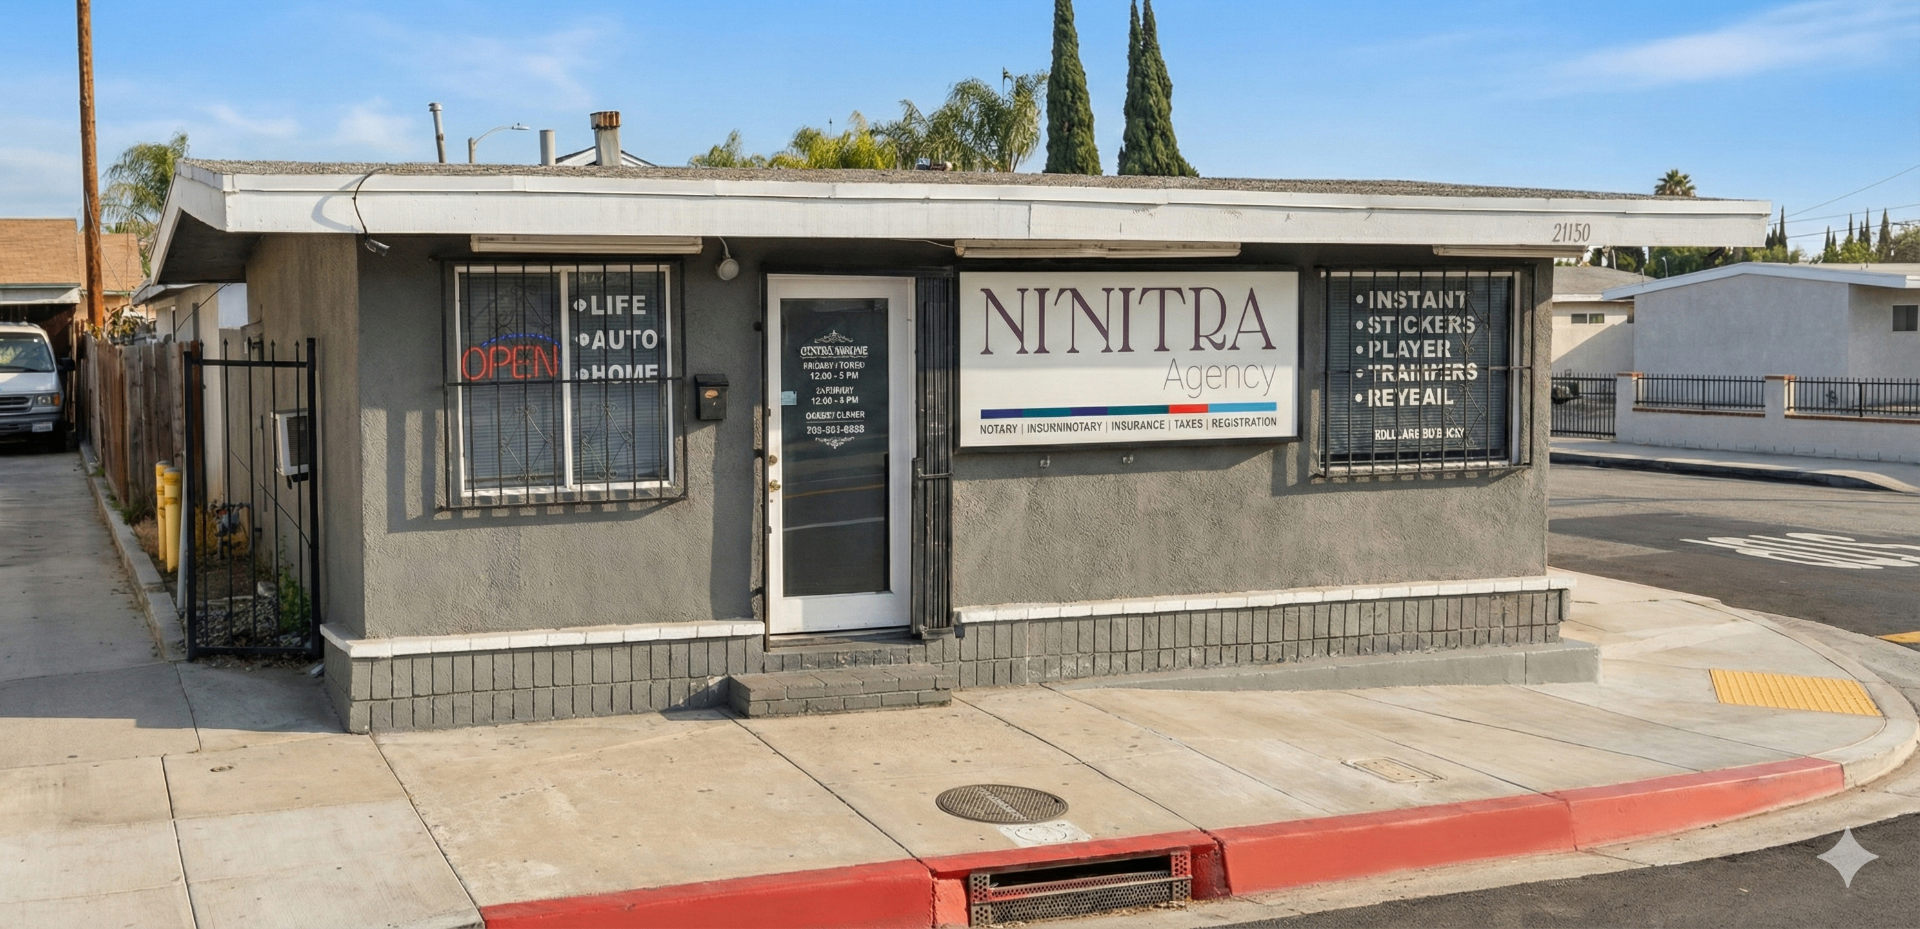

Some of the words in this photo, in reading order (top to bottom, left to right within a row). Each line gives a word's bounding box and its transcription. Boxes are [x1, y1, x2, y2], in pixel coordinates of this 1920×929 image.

[1551, 222, 1591, 242] 21150
[591, 295, 647, 315] LIFE
[1368, 290, 1470, 309] INSTANT
[1367, 315, 1476, 334] STICKERS
[591, 329, 658, 350] AUTO
[1368, 340, 1452, 359] PLAYER
[461, 344, 559, 381] OPEN
[591, 364, 659, 385] HOME
[846, 371, 859, 379] PM
[1163, 358, 1277, 399] Agency
[846, 396, 859, 404] PM
[980, 424, 1018, 435] NOTARY
[1111, 419, 1165, 431] INSURANCE
[1174, 418, 1203, 429] TAXES
[1211, 416, 1277, 428] REGISTRATION
